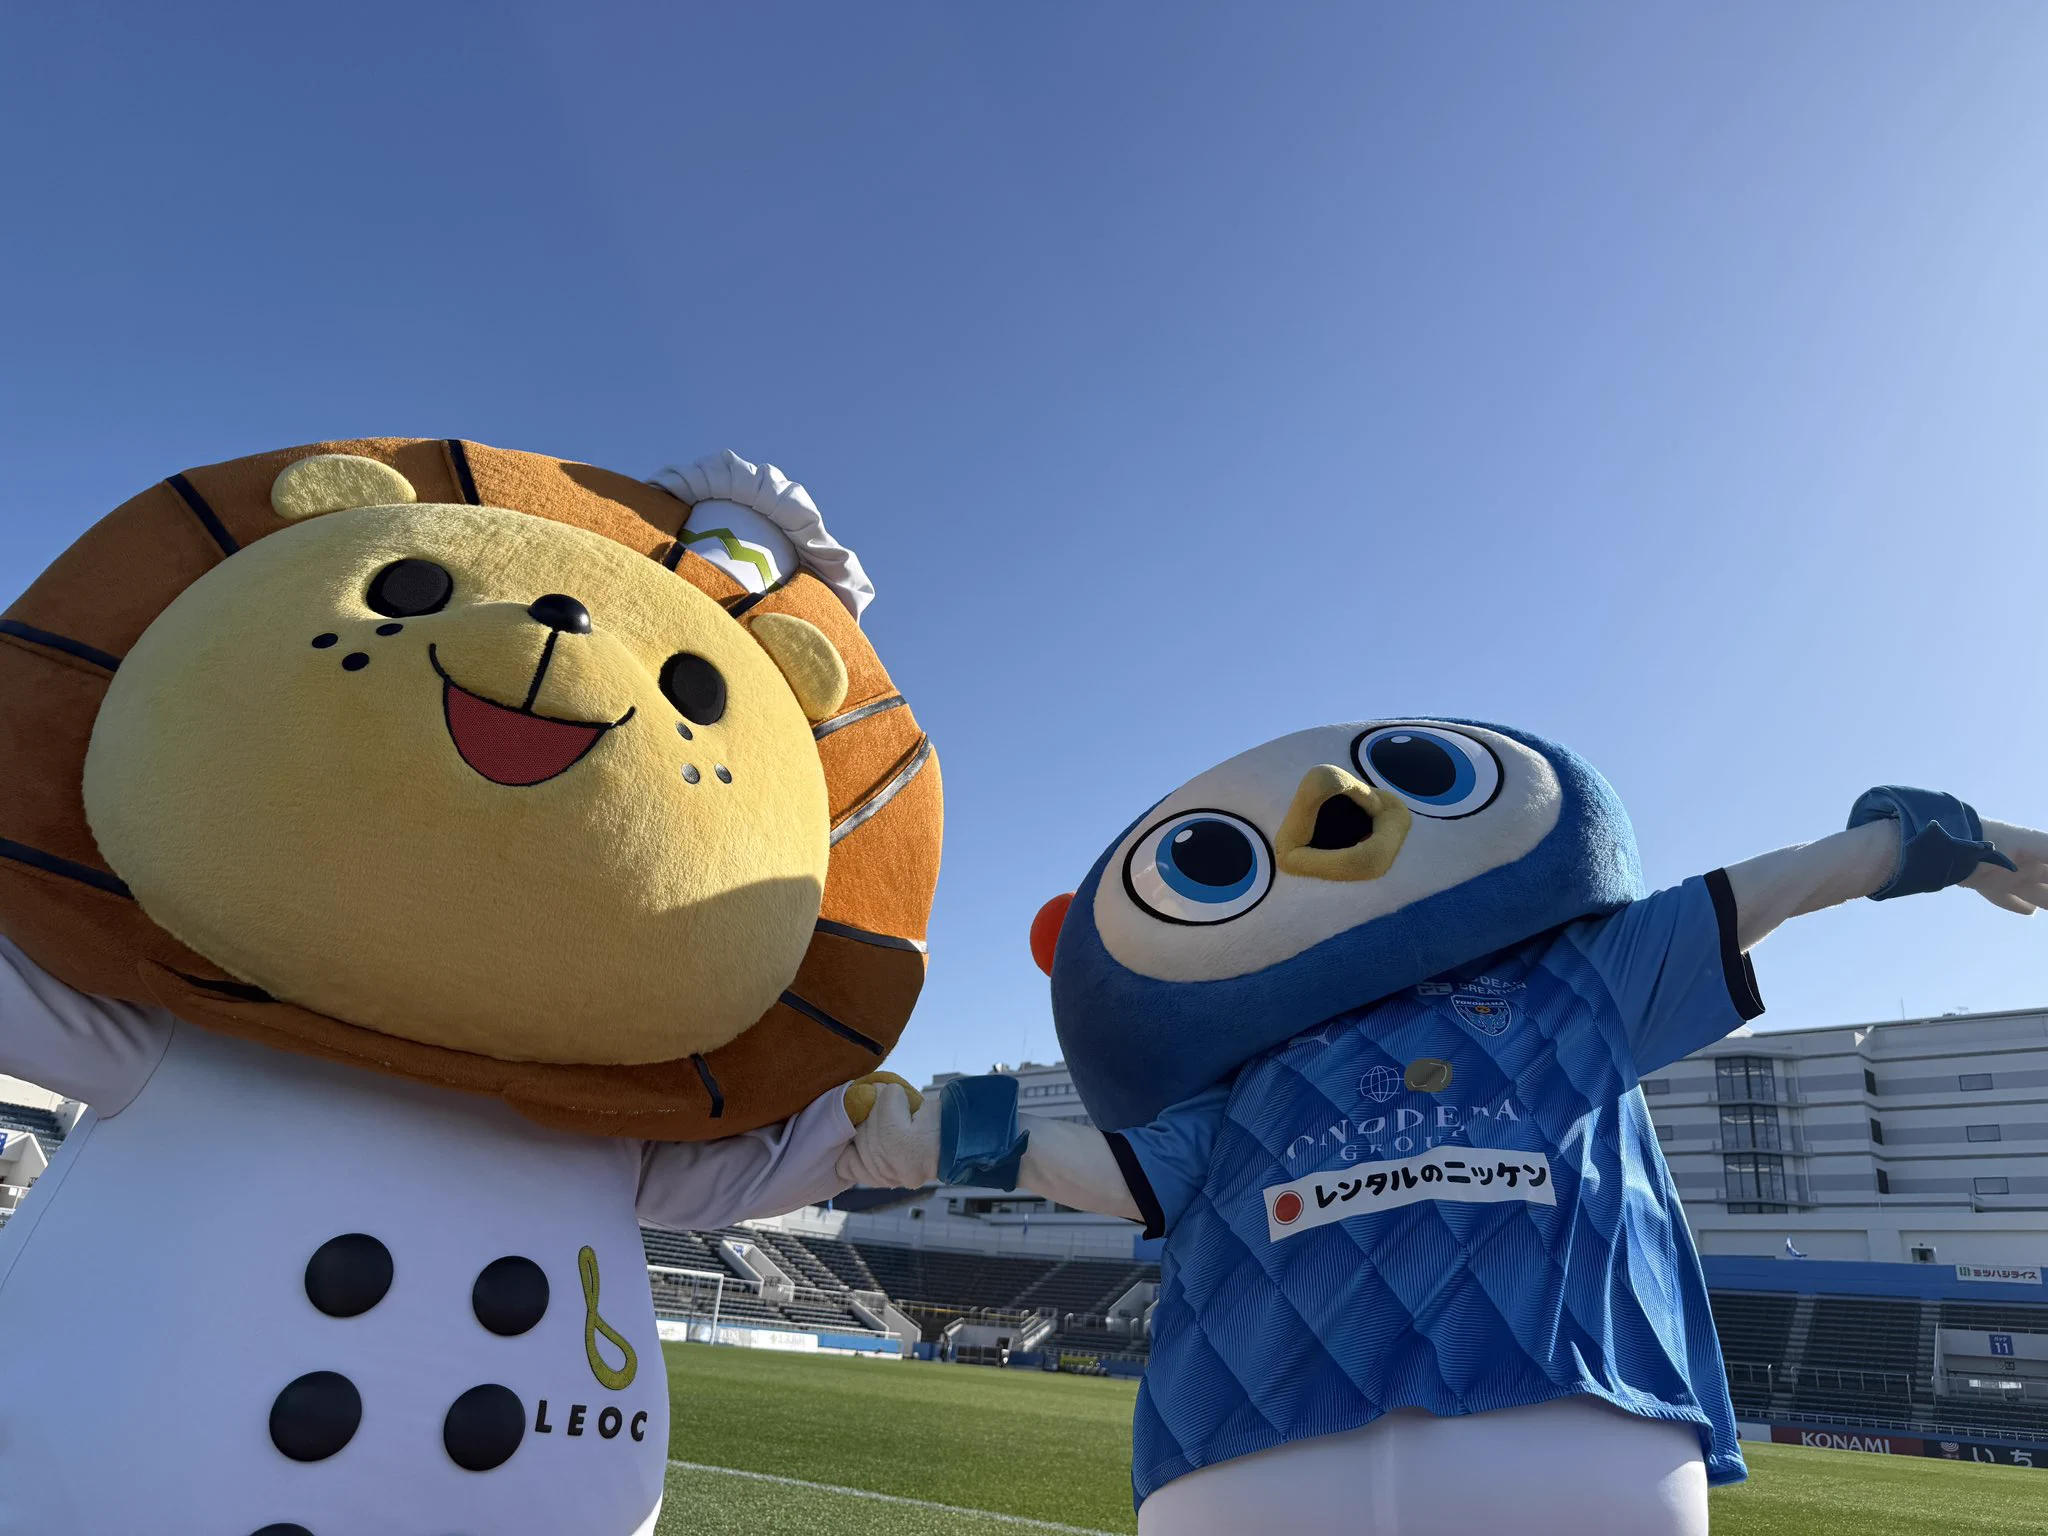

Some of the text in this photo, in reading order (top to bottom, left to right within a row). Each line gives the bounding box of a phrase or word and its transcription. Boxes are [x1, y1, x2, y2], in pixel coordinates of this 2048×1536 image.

[1315, 1161, 1547, 1208] レンタルのニッケン
[1995, 1342, 2009, 1354] 11
[535, 1400, 648, 1442] LEOC
[1801, 1431, 1890, 1454] KONAMI
[1972, 1446, 2033, 1467] いち
